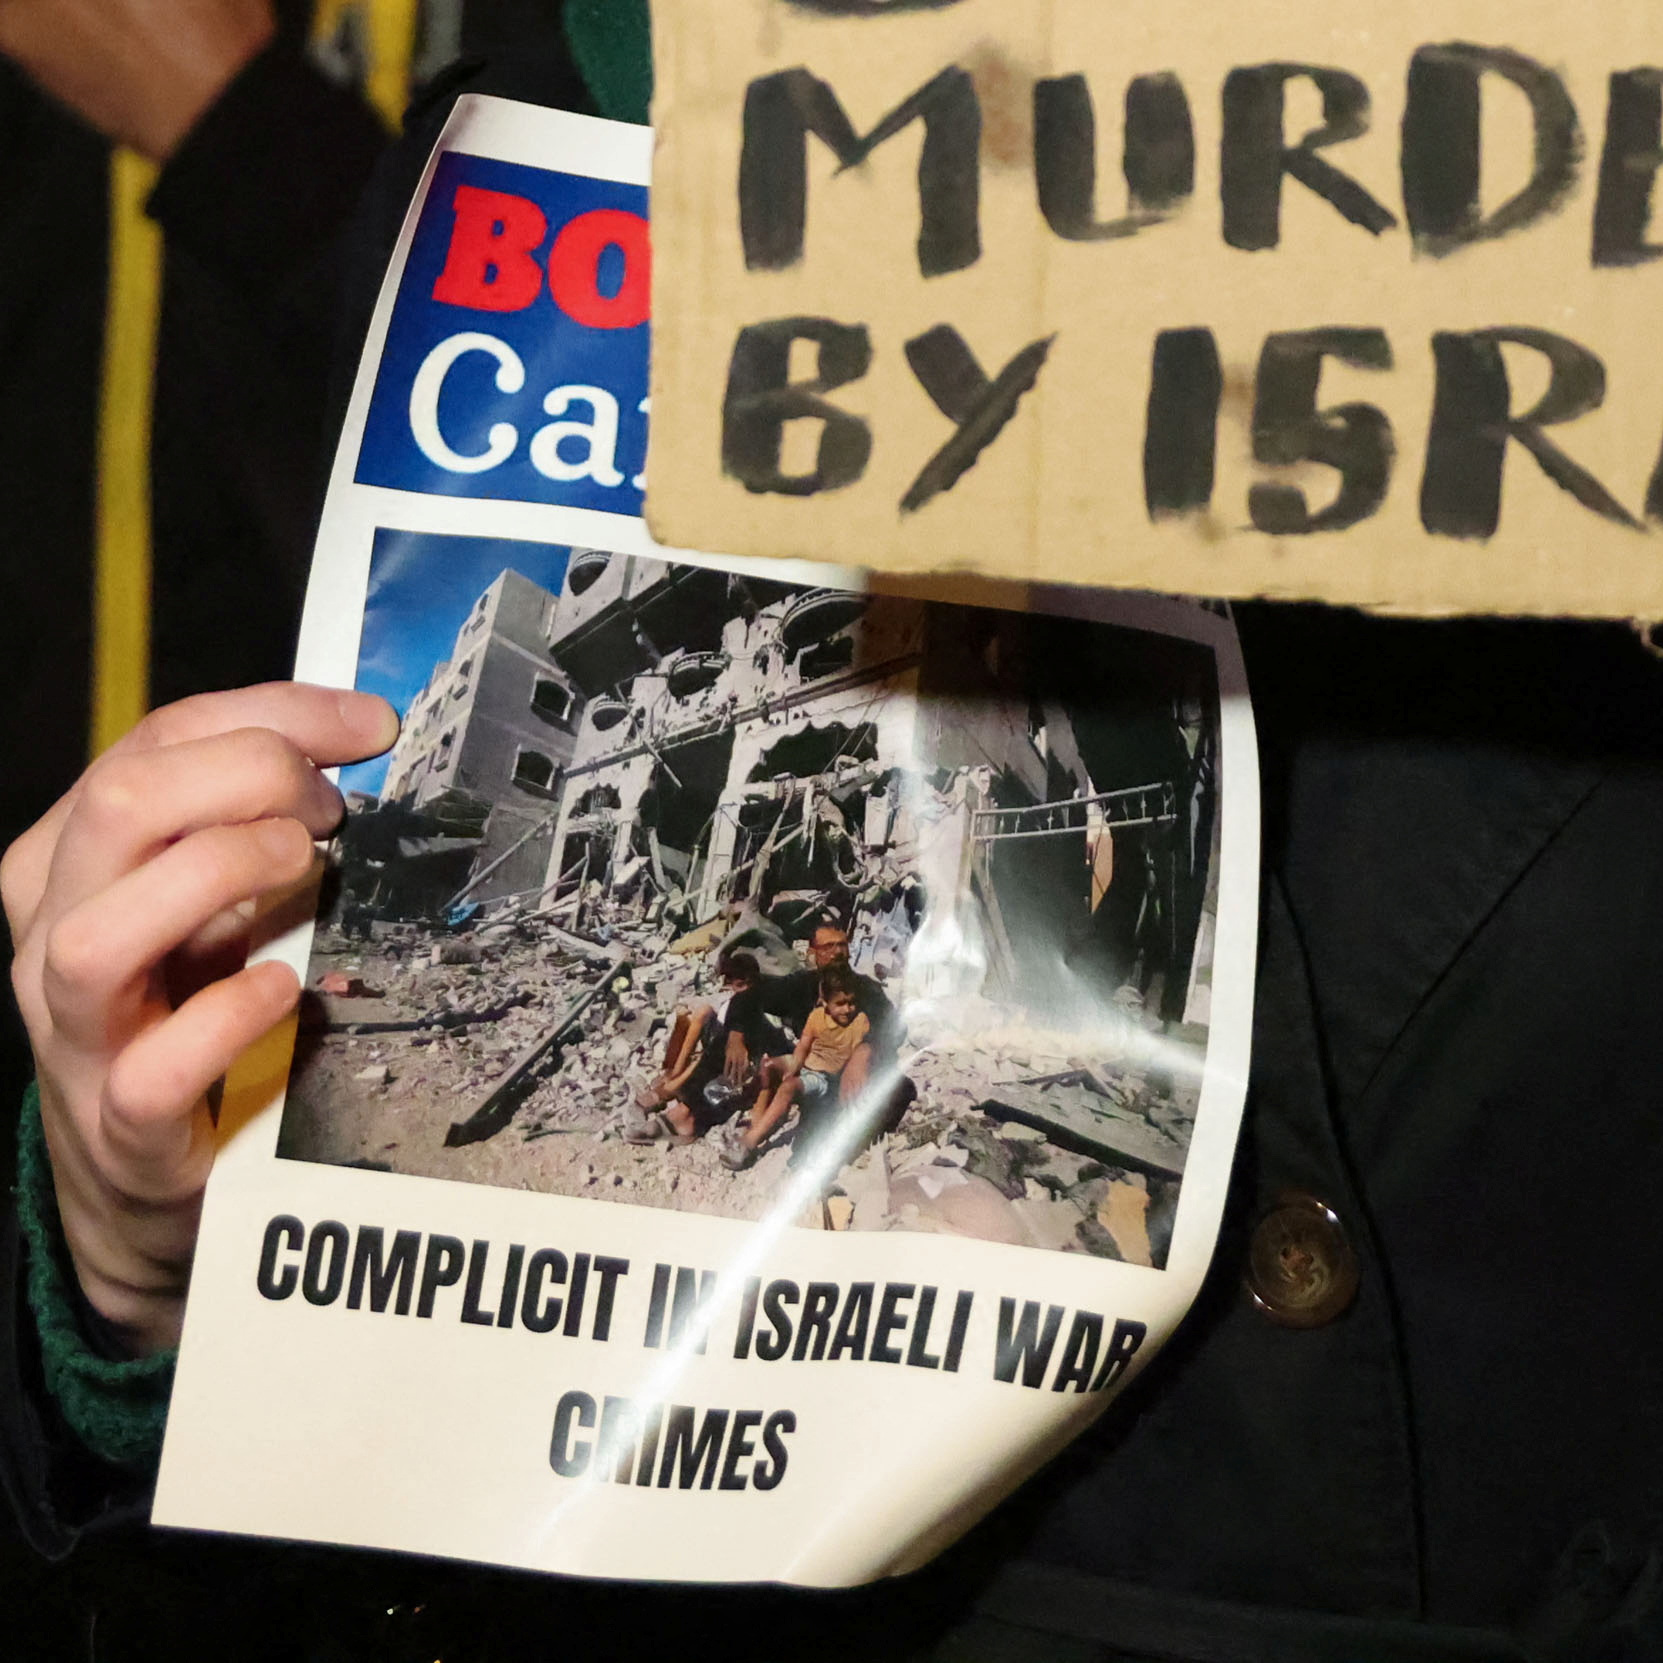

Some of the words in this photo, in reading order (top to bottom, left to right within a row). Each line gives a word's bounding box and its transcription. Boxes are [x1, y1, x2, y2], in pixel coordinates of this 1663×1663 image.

[432, 185, 651, 329] BO
[723, 317, 1052, 512] BY
[256, 1214, 630, 1342] COMPLICIT
[643, 1262, 718, 1356] IN
[734, 1275, 973, 1373] ISRAELI
[993, 1296, 1148, 1394] WAR
[549, 1390, 797, 1491] CRIMES
